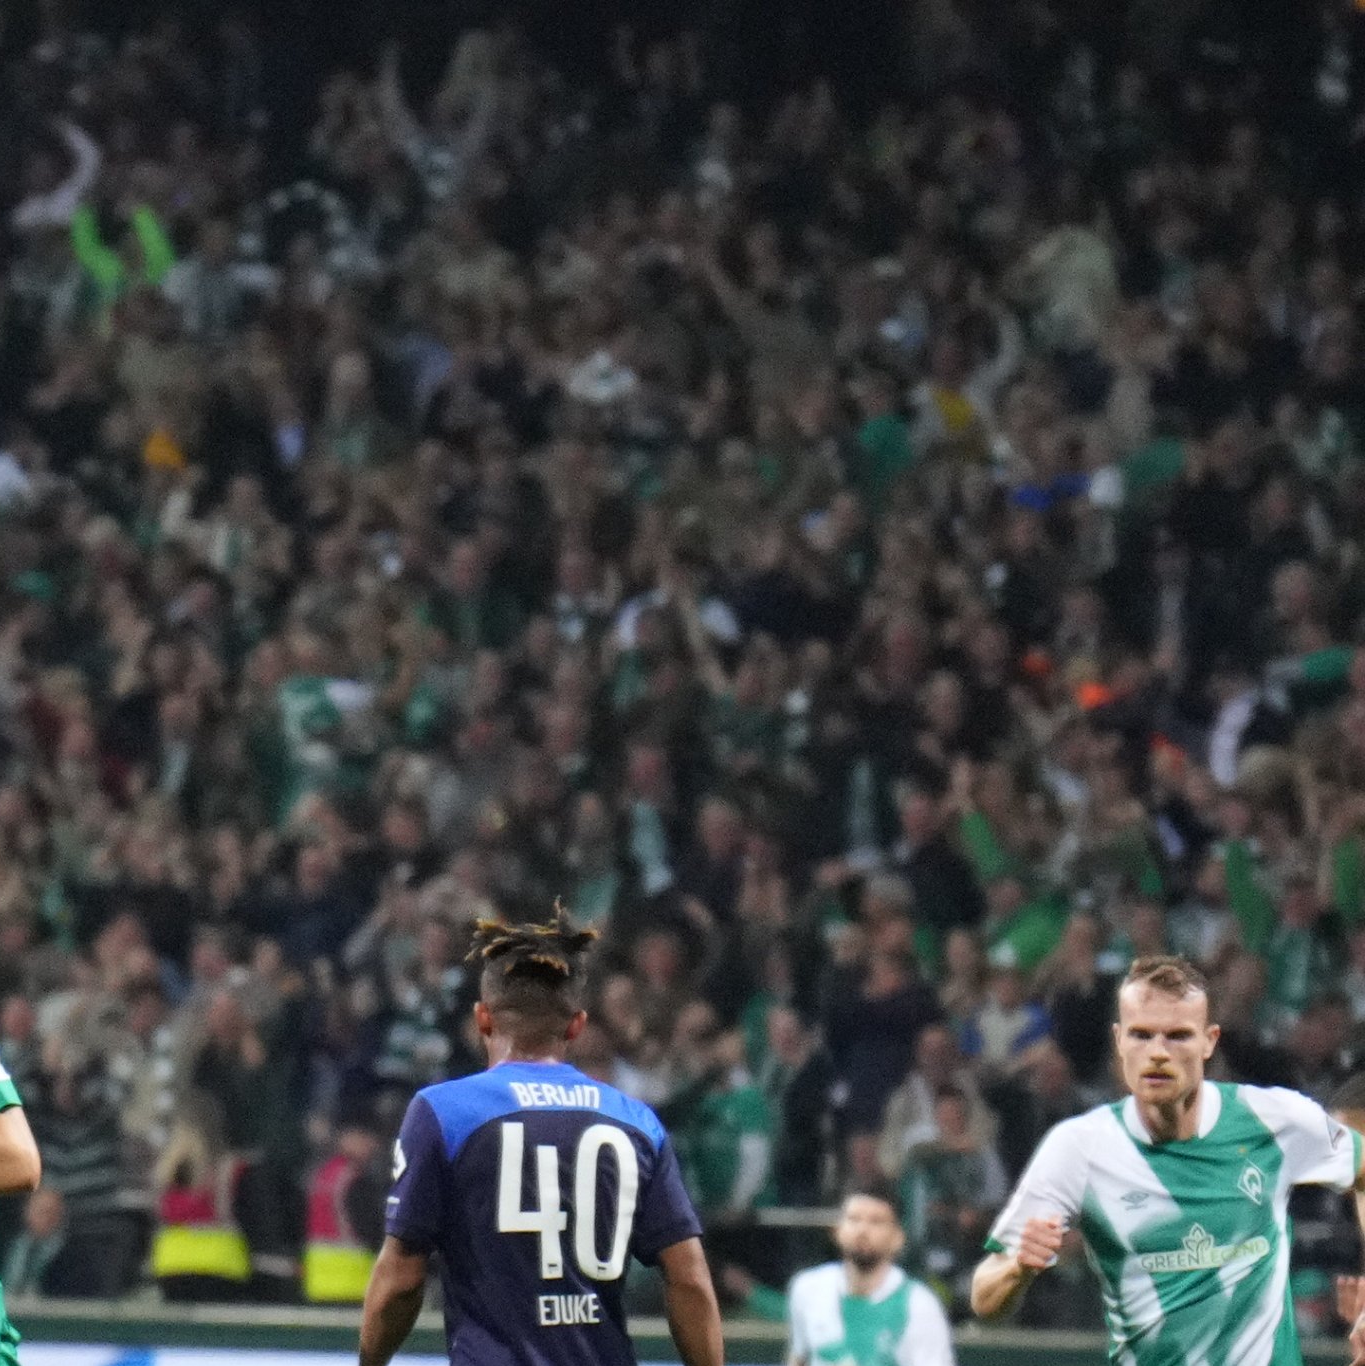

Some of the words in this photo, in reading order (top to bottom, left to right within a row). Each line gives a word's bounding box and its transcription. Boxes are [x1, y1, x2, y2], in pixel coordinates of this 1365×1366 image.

[509, 1081, 601, 1109] BERLIN
[498, 1121, 639, 1281] 40
[538, 1294, 601, 1326] EJUKE
